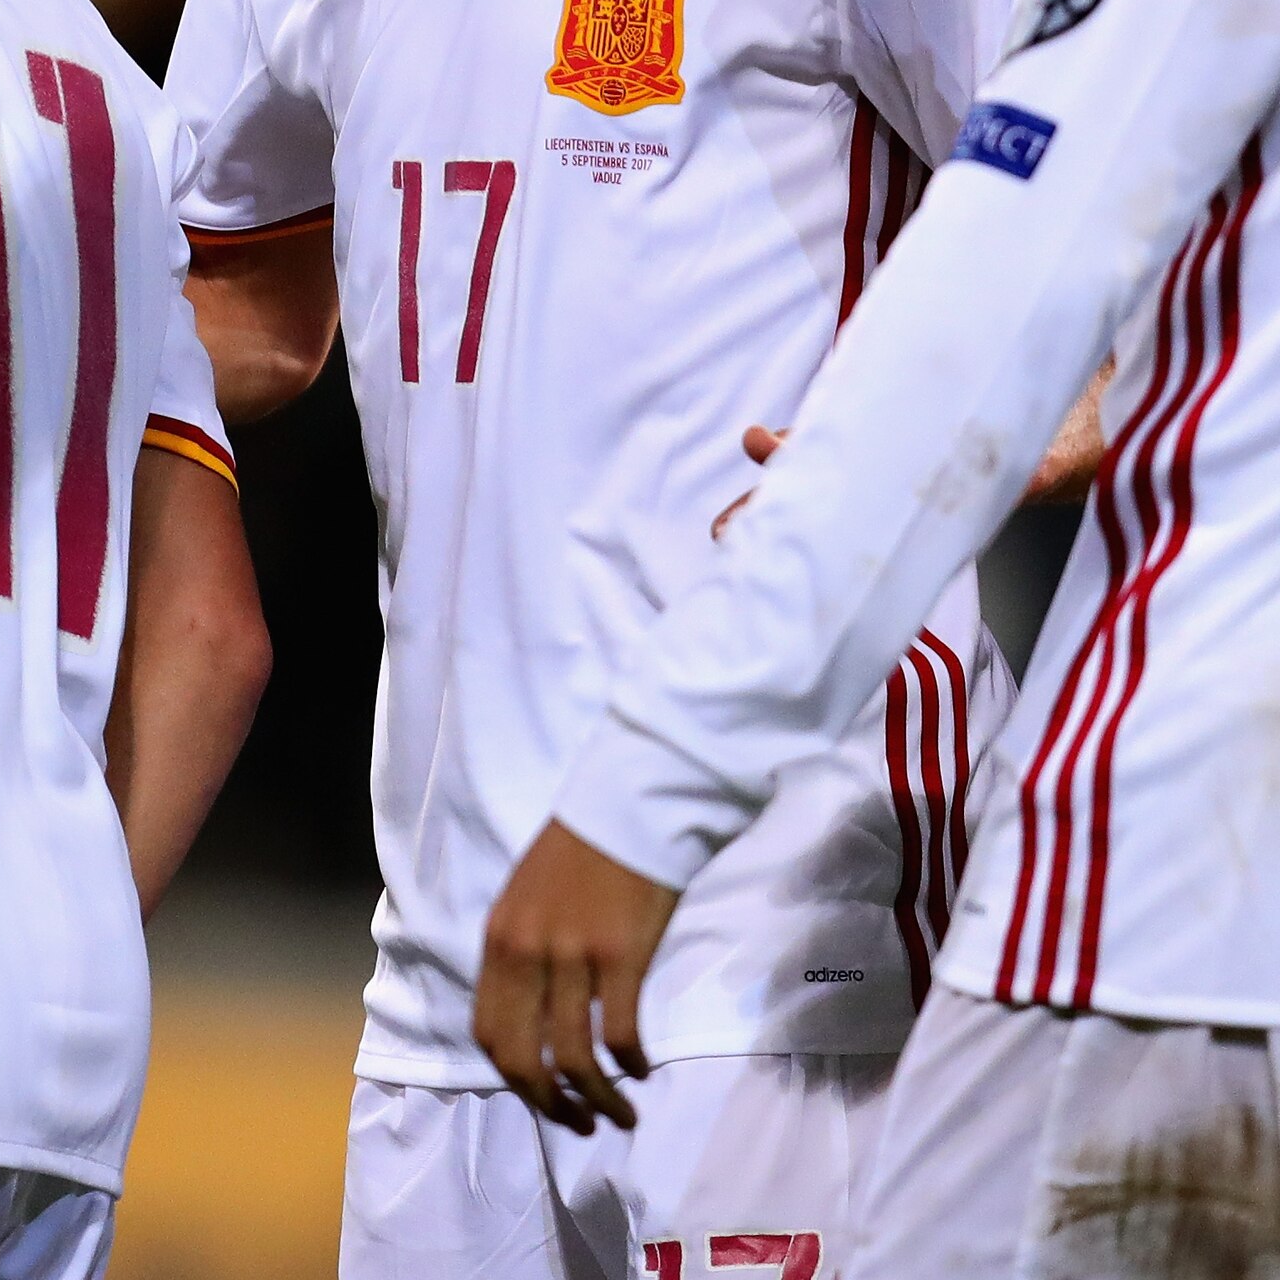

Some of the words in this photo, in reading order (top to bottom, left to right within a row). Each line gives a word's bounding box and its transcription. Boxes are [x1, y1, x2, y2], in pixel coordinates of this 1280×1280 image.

[545, 138, 614, 153] LIECHTENSTEIN
[619, 142, 630, 153] VS
[635, 142, 669, 157] ESPAÑA
[562, 154, 568, 166] 5
[572, 155, 627, 169] SEPTIEMBRE
[631, 158, 653, 170] 2017
[592, 171, 622, 184] VADUZ
[391, 159, 517, 384] 17
[804, 966, 865, 983] adizero
